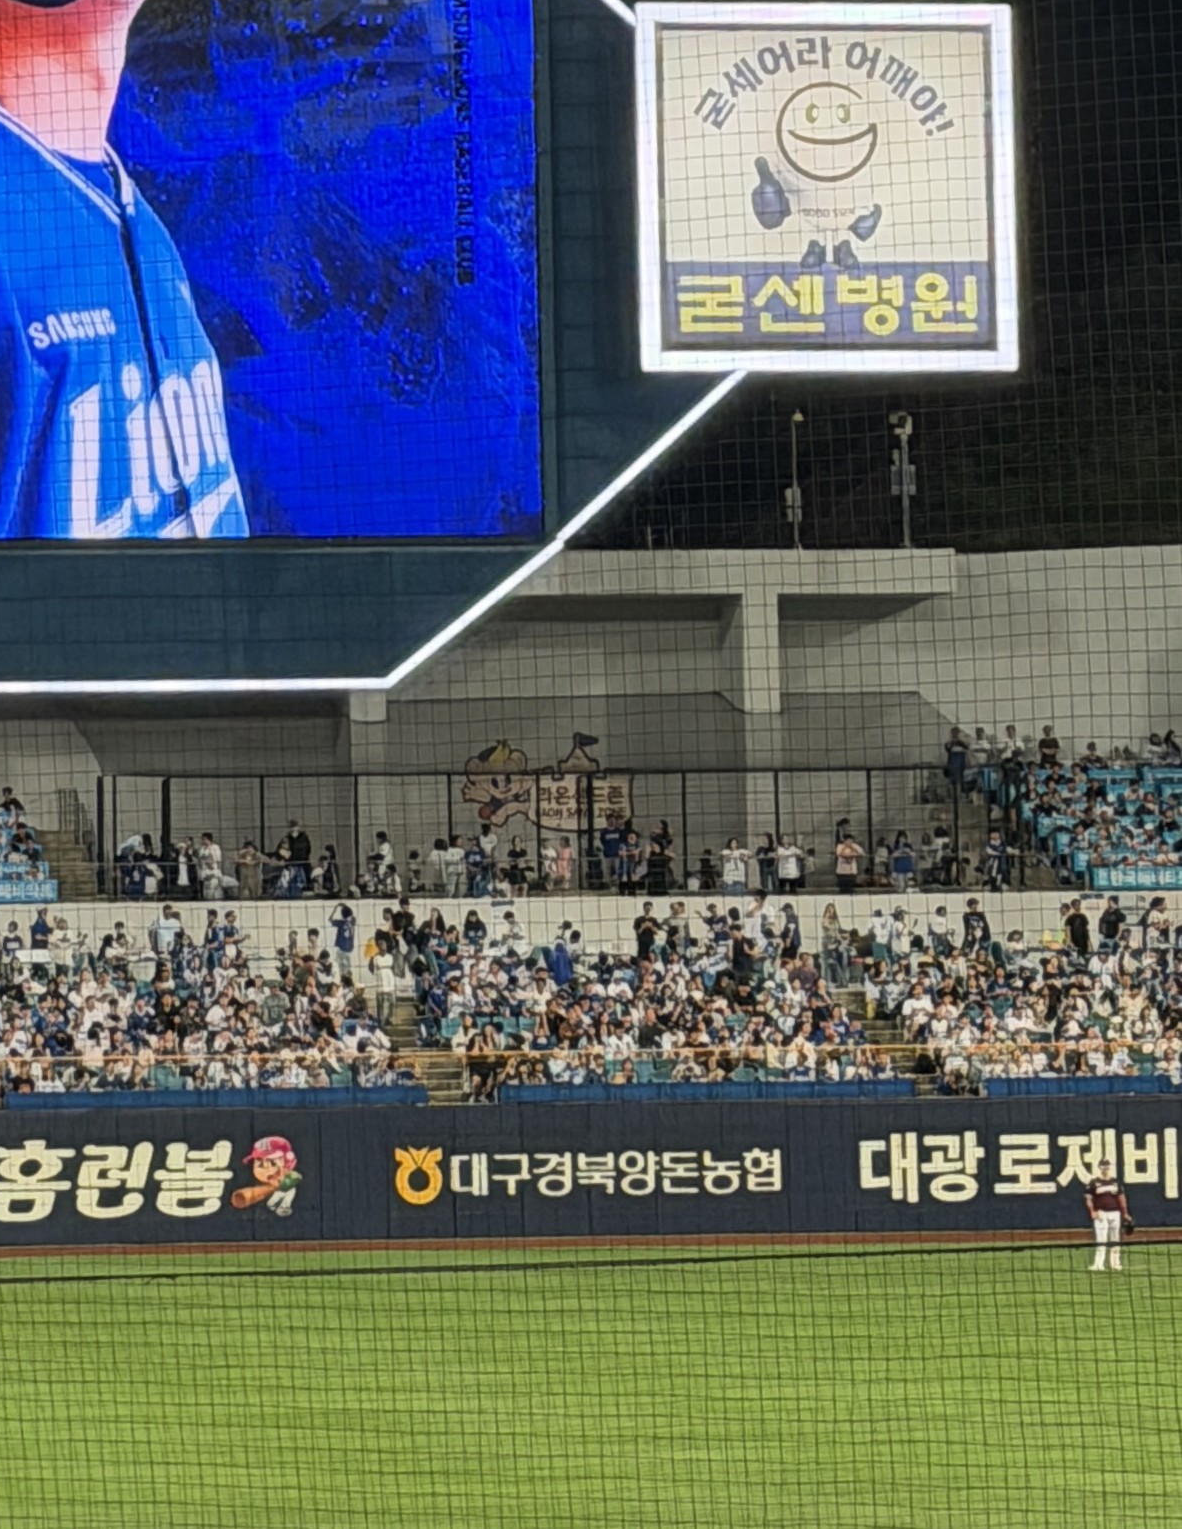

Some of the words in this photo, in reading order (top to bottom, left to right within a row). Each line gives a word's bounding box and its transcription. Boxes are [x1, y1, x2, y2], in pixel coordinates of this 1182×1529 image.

[694, 36, 831, 130] 굳세어라
[28, 308, 116, 349] SAMSUNG
[450, 1147, 783, 1197] 대구경북양돈농협
[858, 1129, 986, 1204] 대광
[993, 1126, 1179, 1200] 로제비
